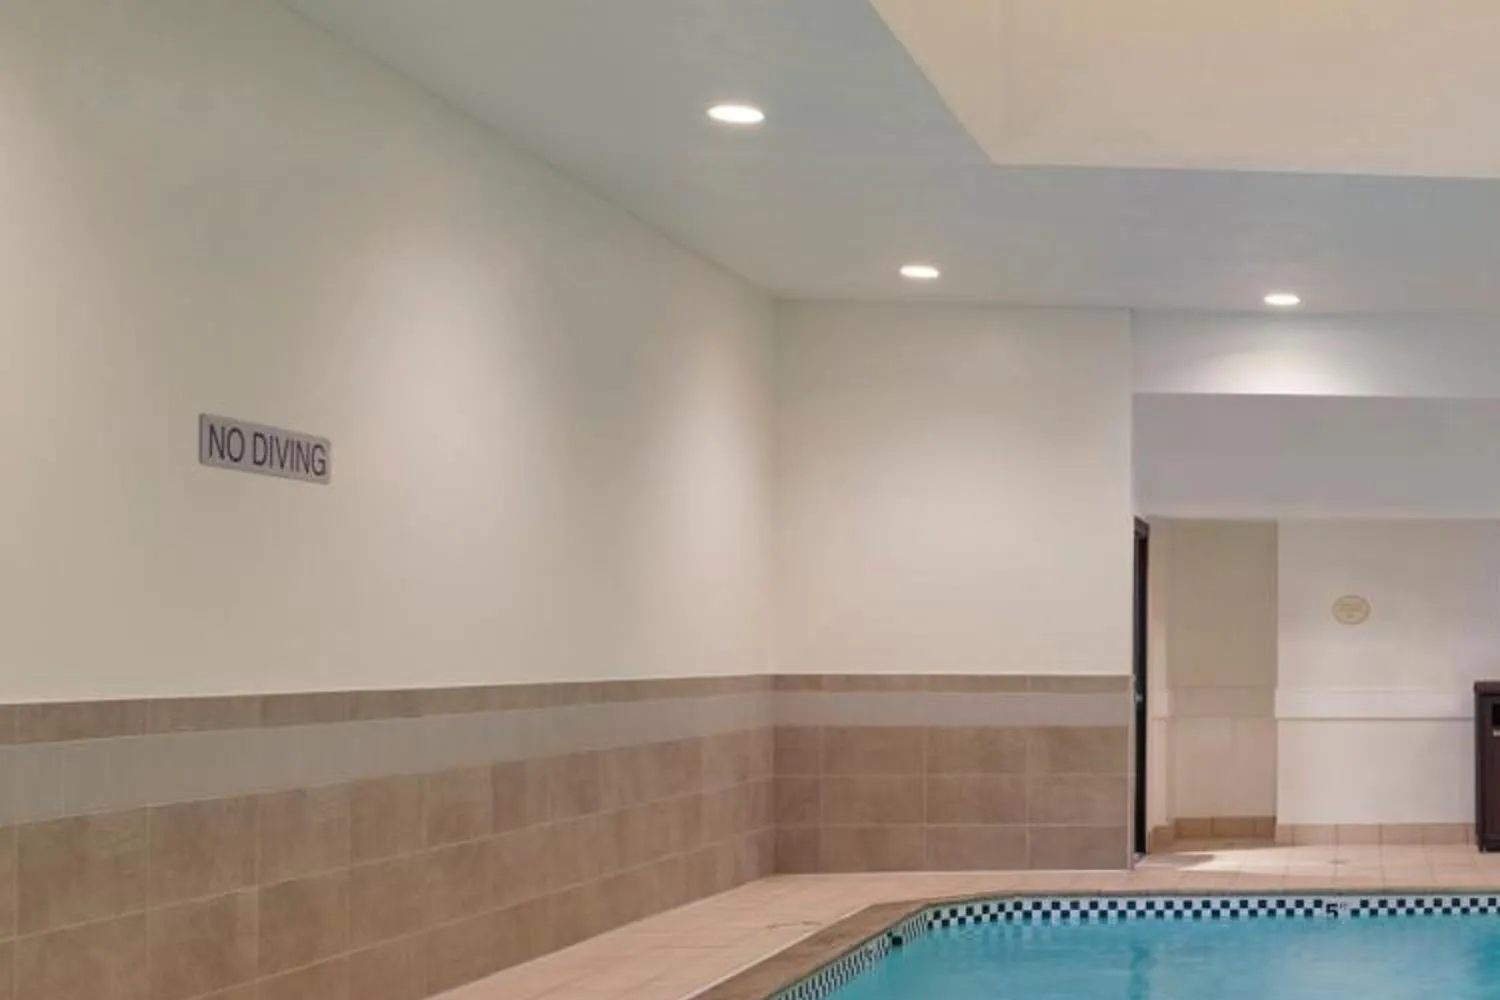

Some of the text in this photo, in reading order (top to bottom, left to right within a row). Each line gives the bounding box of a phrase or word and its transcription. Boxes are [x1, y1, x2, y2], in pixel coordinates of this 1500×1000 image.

[208, 423, 327, 477] NO DIVING
[1326, 902, 1339, 919] 5
